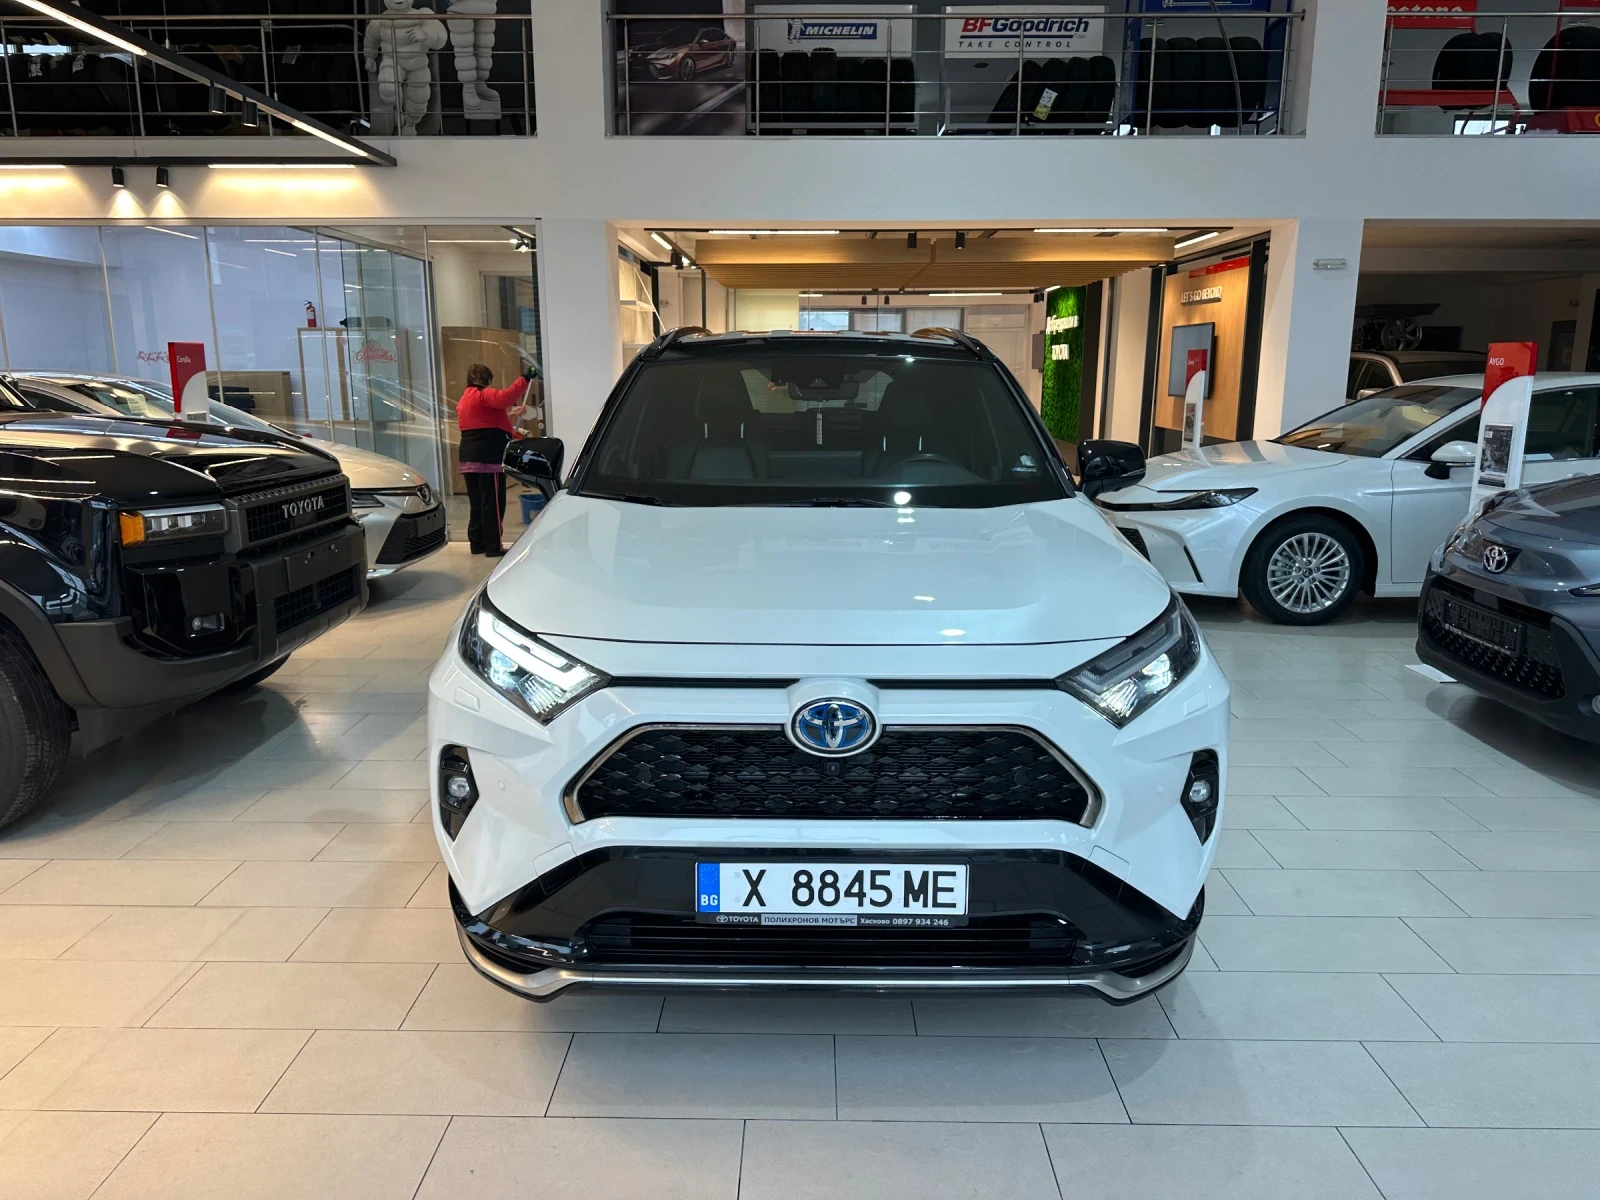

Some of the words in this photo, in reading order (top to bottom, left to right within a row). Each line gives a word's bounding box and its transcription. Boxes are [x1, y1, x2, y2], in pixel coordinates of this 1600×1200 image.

[961, 17, 1090, 33] BFGoodrich
[805, 26, 874, 35] MICHELIN
[1193, 289, 1202, 301] GO
[1488, 357, 1505, 366] AYGO
[282, 495, 325, 519] TOYOTA
[742, 869, 767, 907] X
[791, 869, 893, 908] 8845
[903, 870, 957, 908] ME
[701, 895, 718, 906] BG
[729, 915, 759, 923] TOYOTA
[764, 916, 820, 924] ПОЛИХРОНОВ
[821, 917, 856, 925] МОТЪРС
[860, 917, 890, 925] Хасково
[892, 918, 913, 926] 0897
[915, 918, 931, 926] 934
